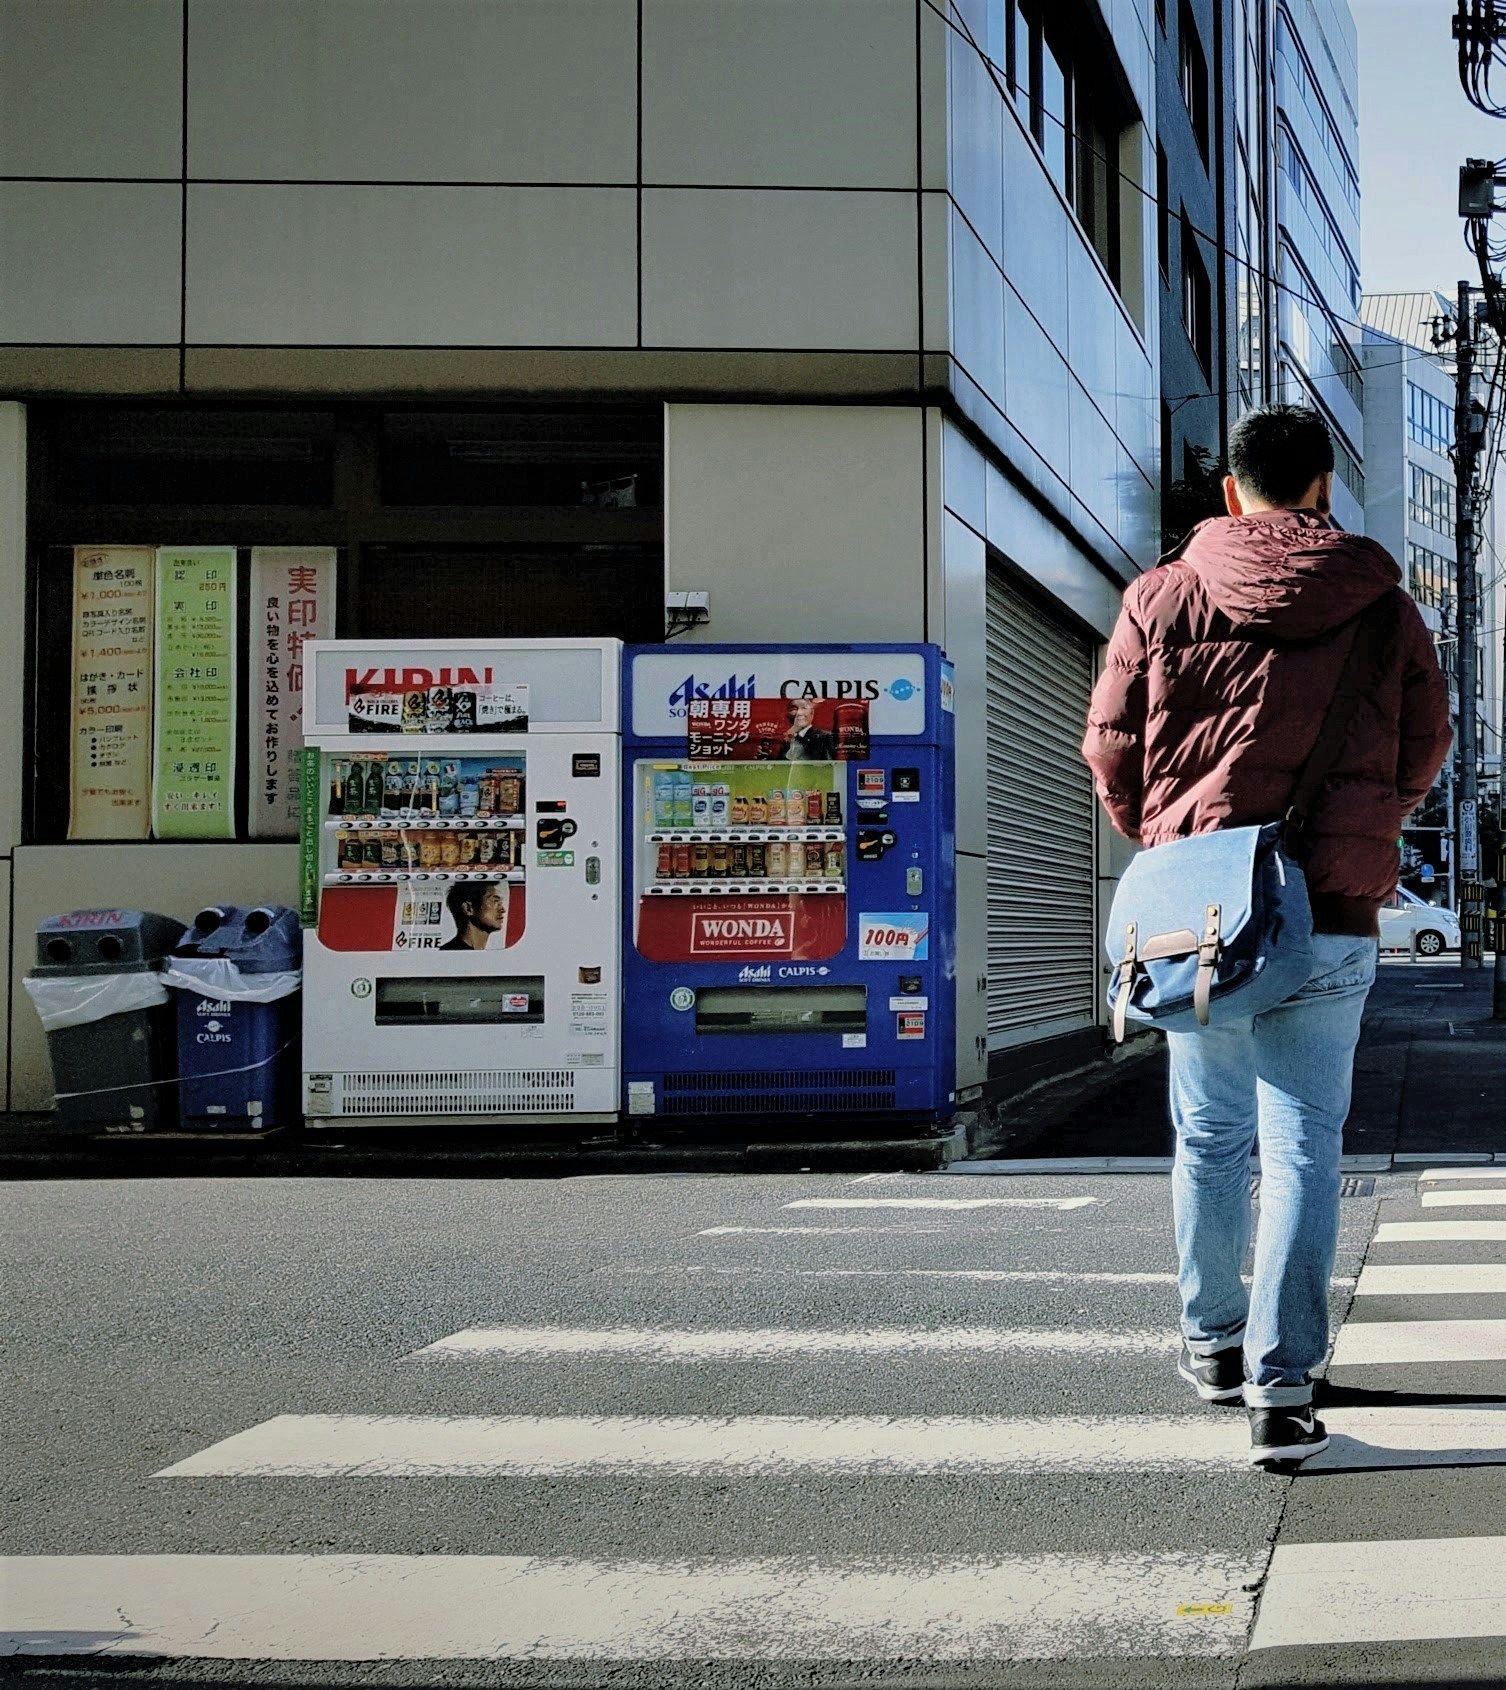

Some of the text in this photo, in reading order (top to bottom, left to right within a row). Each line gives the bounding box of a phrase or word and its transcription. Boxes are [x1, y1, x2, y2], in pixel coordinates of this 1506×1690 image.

[199, 582, 227, 592] 250円
[668, 673, 880, 706] Asahi CALPIS
[265, 597, 280, 805] 良い物を心を込めてお作りします
[366, 704, 398, 715] FIRE
[668, 708, 688, 718] SO
[689, 700, 751, 718] 朝専用
[713, 719, 751, 731] ワンダ
[689, 731, 750, 743] モーニング
[690, 743, 734, 755] ショット
[57, 912, 124, 927] KIRIN
[701, 919, 785, 938] WONDA
[408, 937, 442, 949] FIRE
[865, 929, 909, 946] 100円
[738, 965, 816, 978] Asahi CALPIS
[196, 999, 231, 1013] Asahi
[196, 1033, 232, 1044] CALPIS
